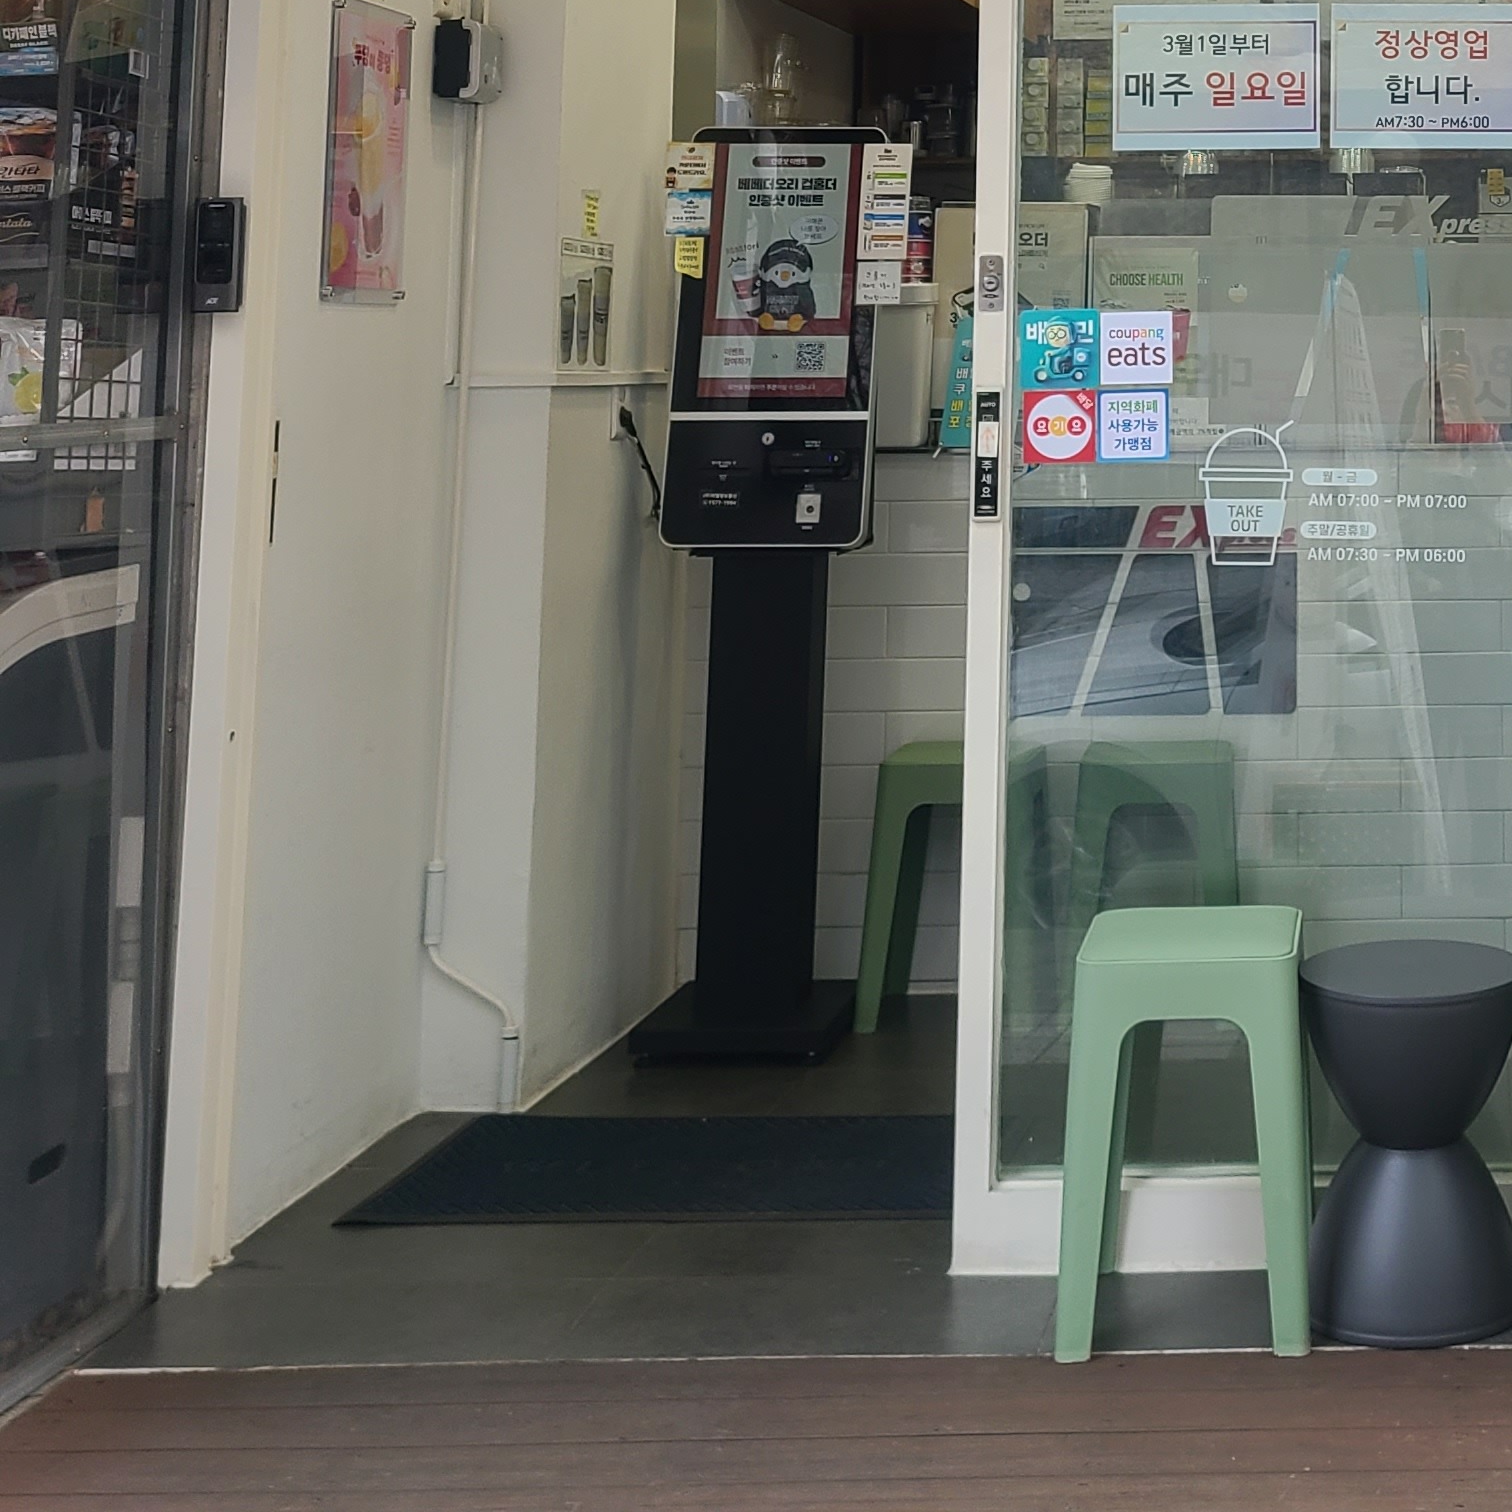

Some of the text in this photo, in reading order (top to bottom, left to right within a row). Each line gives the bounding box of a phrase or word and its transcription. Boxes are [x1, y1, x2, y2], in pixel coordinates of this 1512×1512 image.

[1374, 29, 1490, 61] 정상영업
[1124, 70, 1308, 108] 매주 일요일
[1384, 74, 1481, 106] 합니다.
[1375, 115, 1425, 130] AM7:30
[1441, 115, 1491, 130] PM6:00
[748, 194, 824, 207] 인증샷 이벤트
[1109, 272, 1184, 286] CHOOSE HEALTH
[1108, 326, 1165, 342] coupang
[1107, 342, 1166, 367] eats
[1107, 399, 1159, 414] 지역화폐
[1035, 418, 1083, 433] 요기요
[1108, 418, 1159, 433] 사용가능
[1113, 437, 1153, 452] 가맹점
[1308, 493, 1333, 507] AM
[1337, 494, 1379, 507] 07:00
[1397, 495, 1420, 508] PM
[1424, 495, 1467, 509] 07:00
[1227, 504, 1264, 519] TAKE
[1230, 519, 1261, 532] OUT
[1307, 523, 1370, 537] 주말/공휴일
[1307, 547, 1331, 561] AM
[1336, 548, 1378, 561] 07:30
[1396, 549, 1419, 562] PM
[1424, 549, 1466, 563] 06:00
